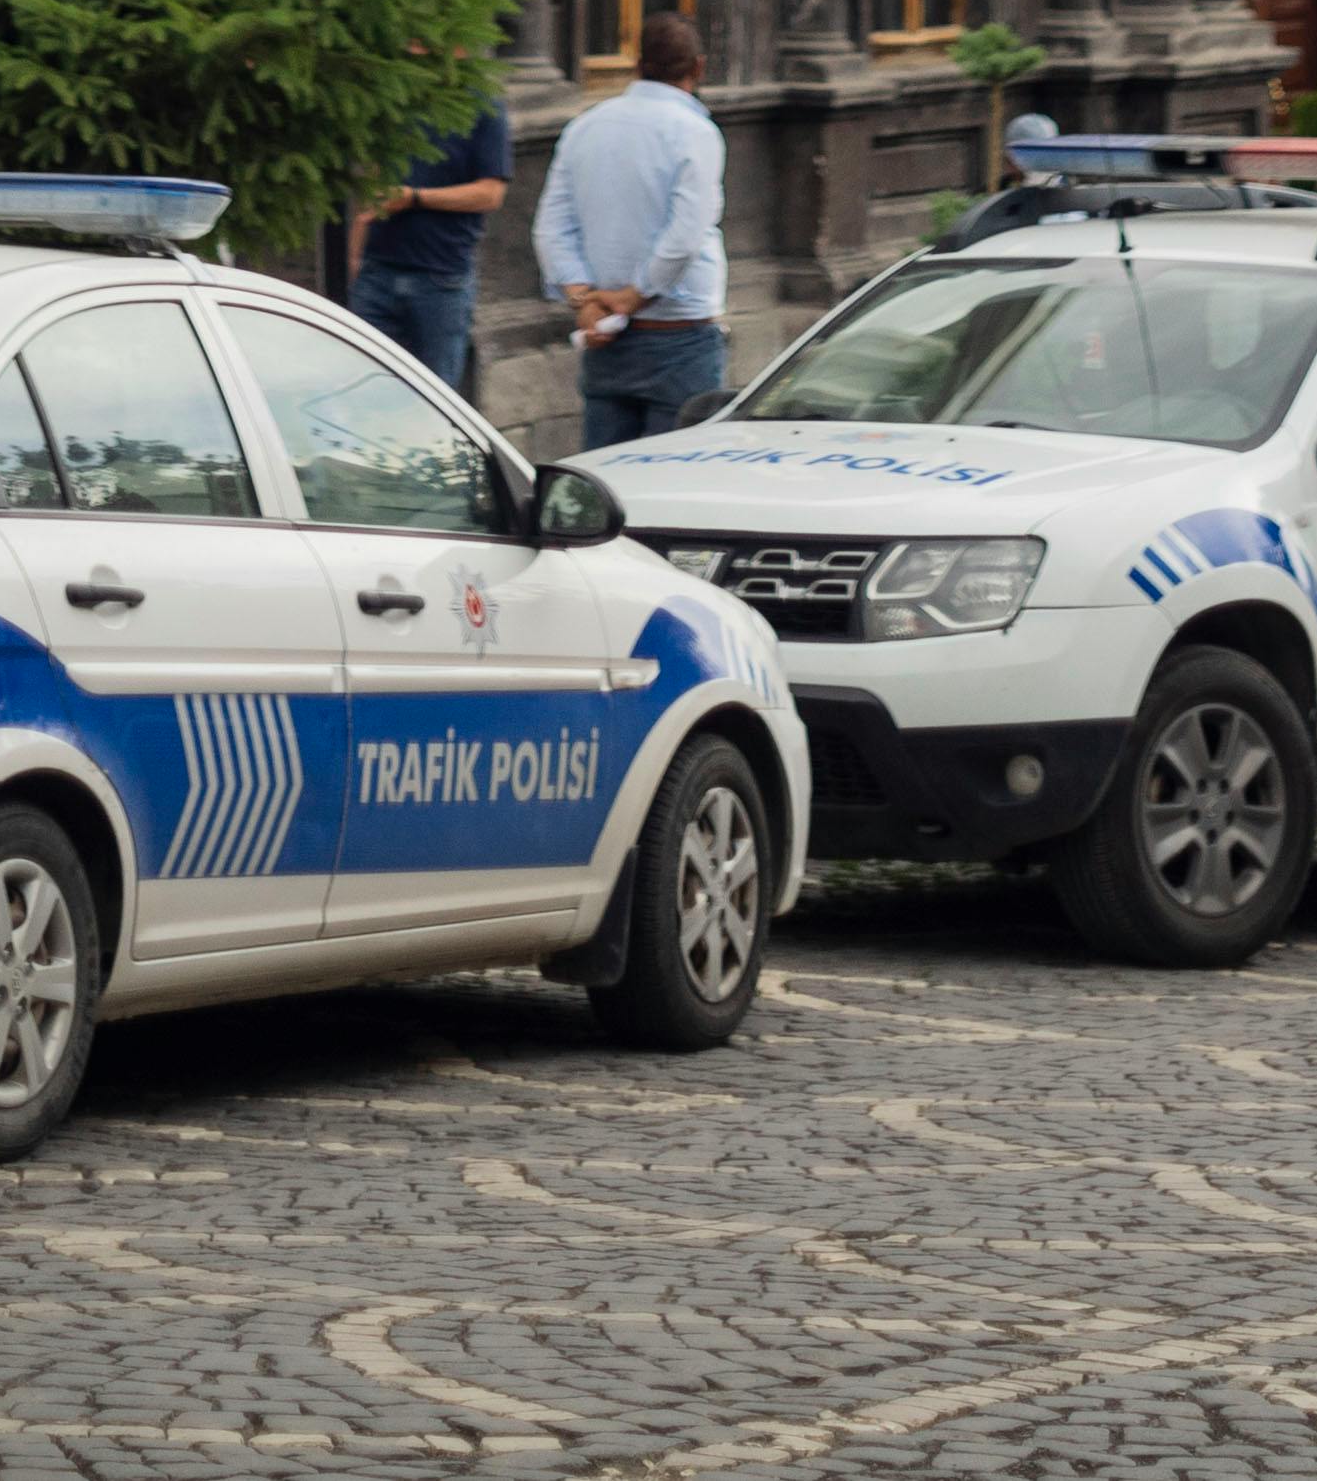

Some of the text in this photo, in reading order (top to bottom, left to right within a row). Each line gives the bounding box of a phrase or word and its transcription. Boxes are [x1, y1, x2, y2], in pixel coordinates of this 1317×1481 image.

[600, 447, 1015, 487] TRAFİK POLİSİ
[358, 725, 600, 805] TRAFİK POLİSİ
